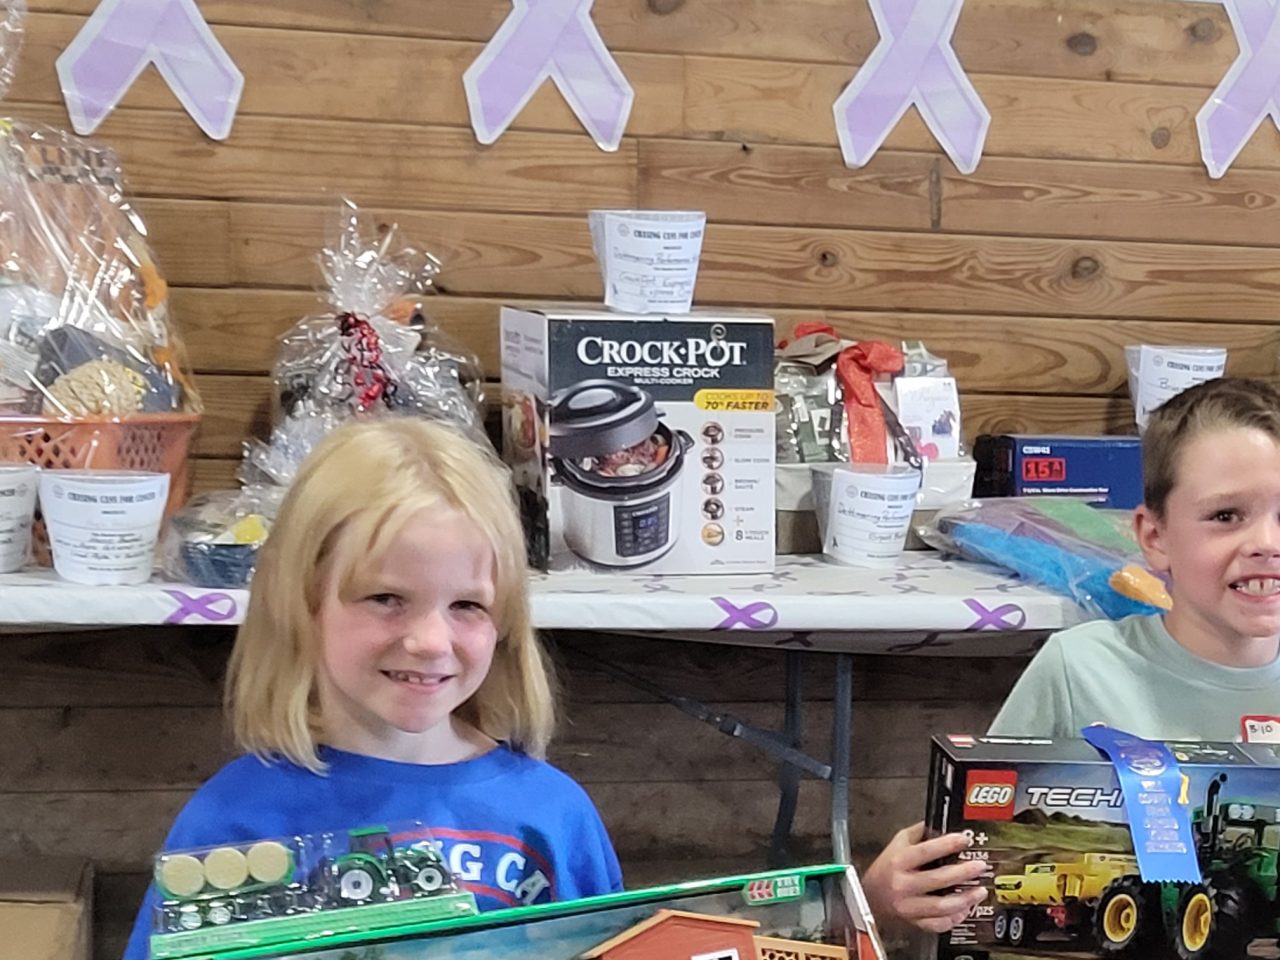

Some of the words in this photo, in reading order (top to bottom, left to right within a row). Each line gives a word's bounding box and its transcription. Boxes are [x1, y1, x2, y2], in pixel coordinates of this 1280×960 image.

[607, 366, 670, 378] EXPRESS
[673, 367, 720, 378] CROCK
[634, 377, 694, 385] MULTI-COOKER
[726, 402, 769, 410] FASTER
[735, 530, 744, 541] 8
[970, 786, 1013, 805] LEGO
[1027, 787, 1122, 807] TECH
